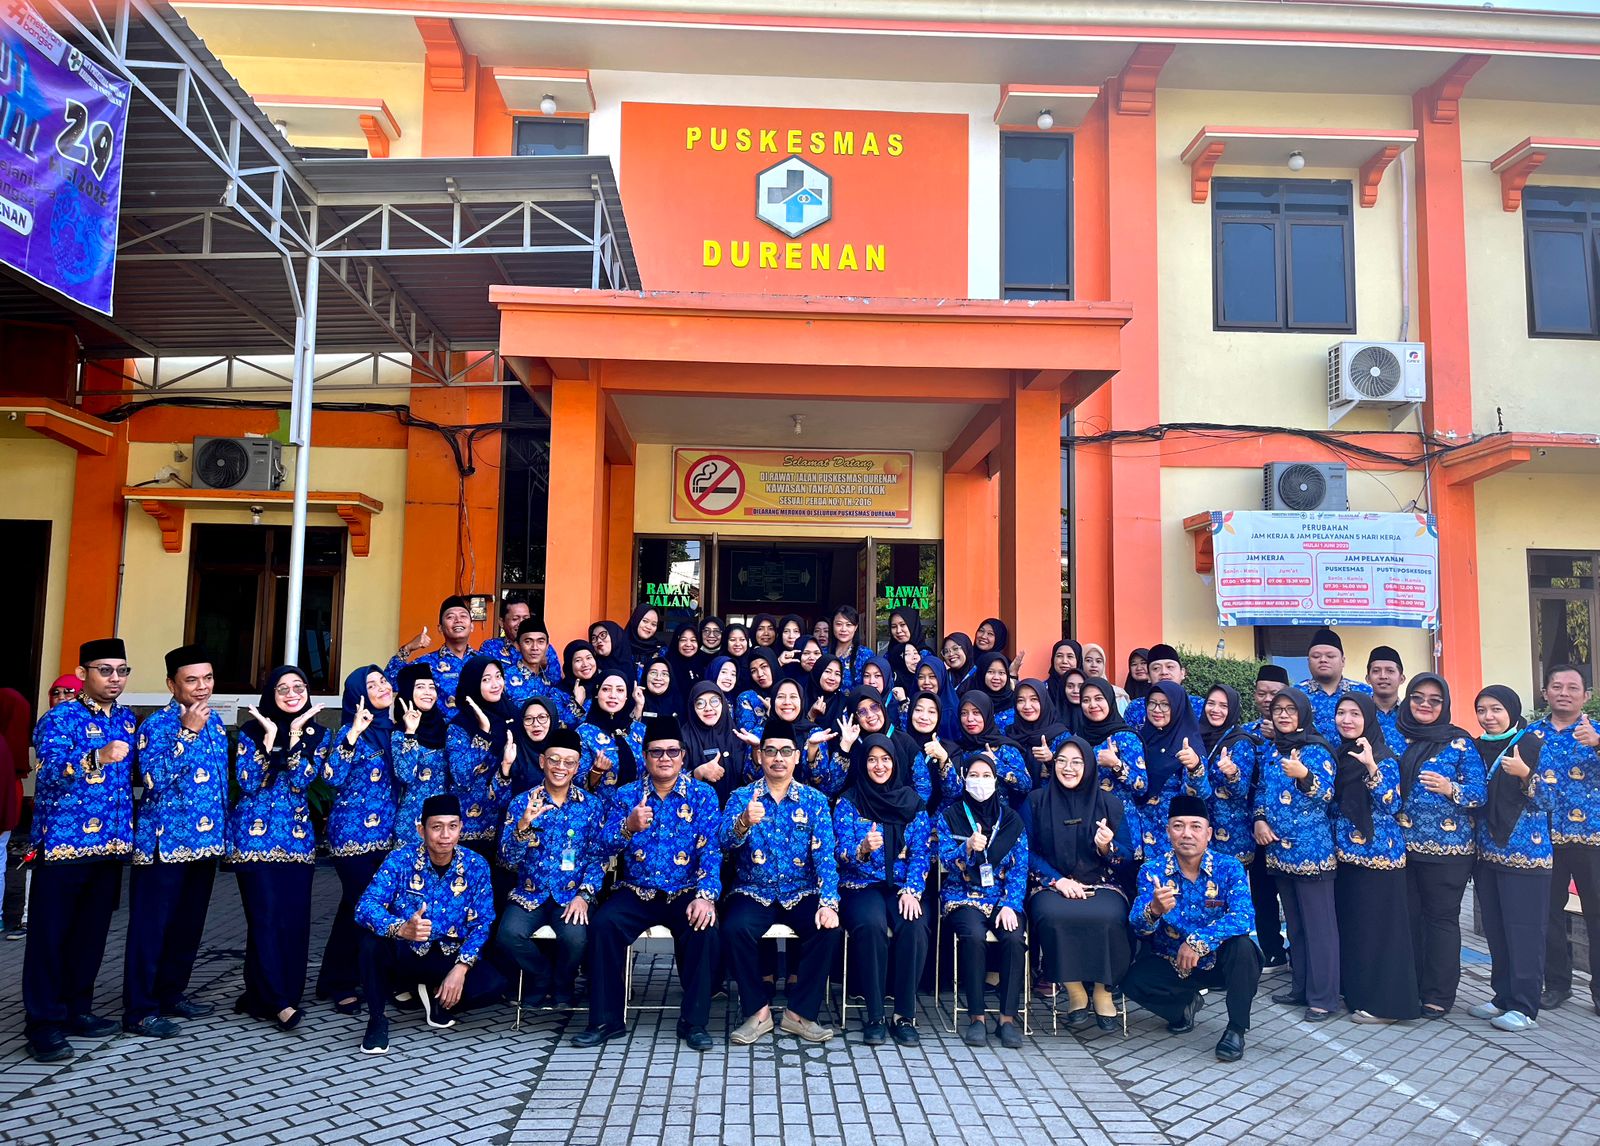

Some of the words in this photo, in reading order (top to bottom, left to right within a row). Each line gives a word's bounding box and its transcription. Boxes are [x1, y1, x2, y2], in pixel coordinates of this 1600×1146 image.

[22, 22, 53, 51] bangsa
[56, 98, 114, 182] 29
[686, 127, 904, 156] PUSKESMAS
[79, 174, 109, 207] 2025
[703, 240, 885, 271] DURENAN
[784, 456, 830, 468] Selamat
[832, 456, 874, 471] Datang
[760, 472, 768, 481] DI
[770, 472, 795, 482] RAWAT
[796, 473, 817, 482] JALAN
[818, 474, 862, 483] PUSKESMAS
[864, 474, 897, 484] DURENAN
[766, 484, 806, 494] KAWASAN
[808, 484, 833, 494] TANPA
[834, 485, 856, 494] ASAP
[858, 486, 886, 495] ROKOK
[780, 496, 802, 505] SESUAI
[805, 496, 828, 506] PERDA
[855, 498, 872, 506] 2016
[646, 583, 690, 595] RAWAT
[885, 586, 928, 598] RAWAT
[646, 595, 690, 606] JALAN
[885, 598, 929, 610] JALAN
